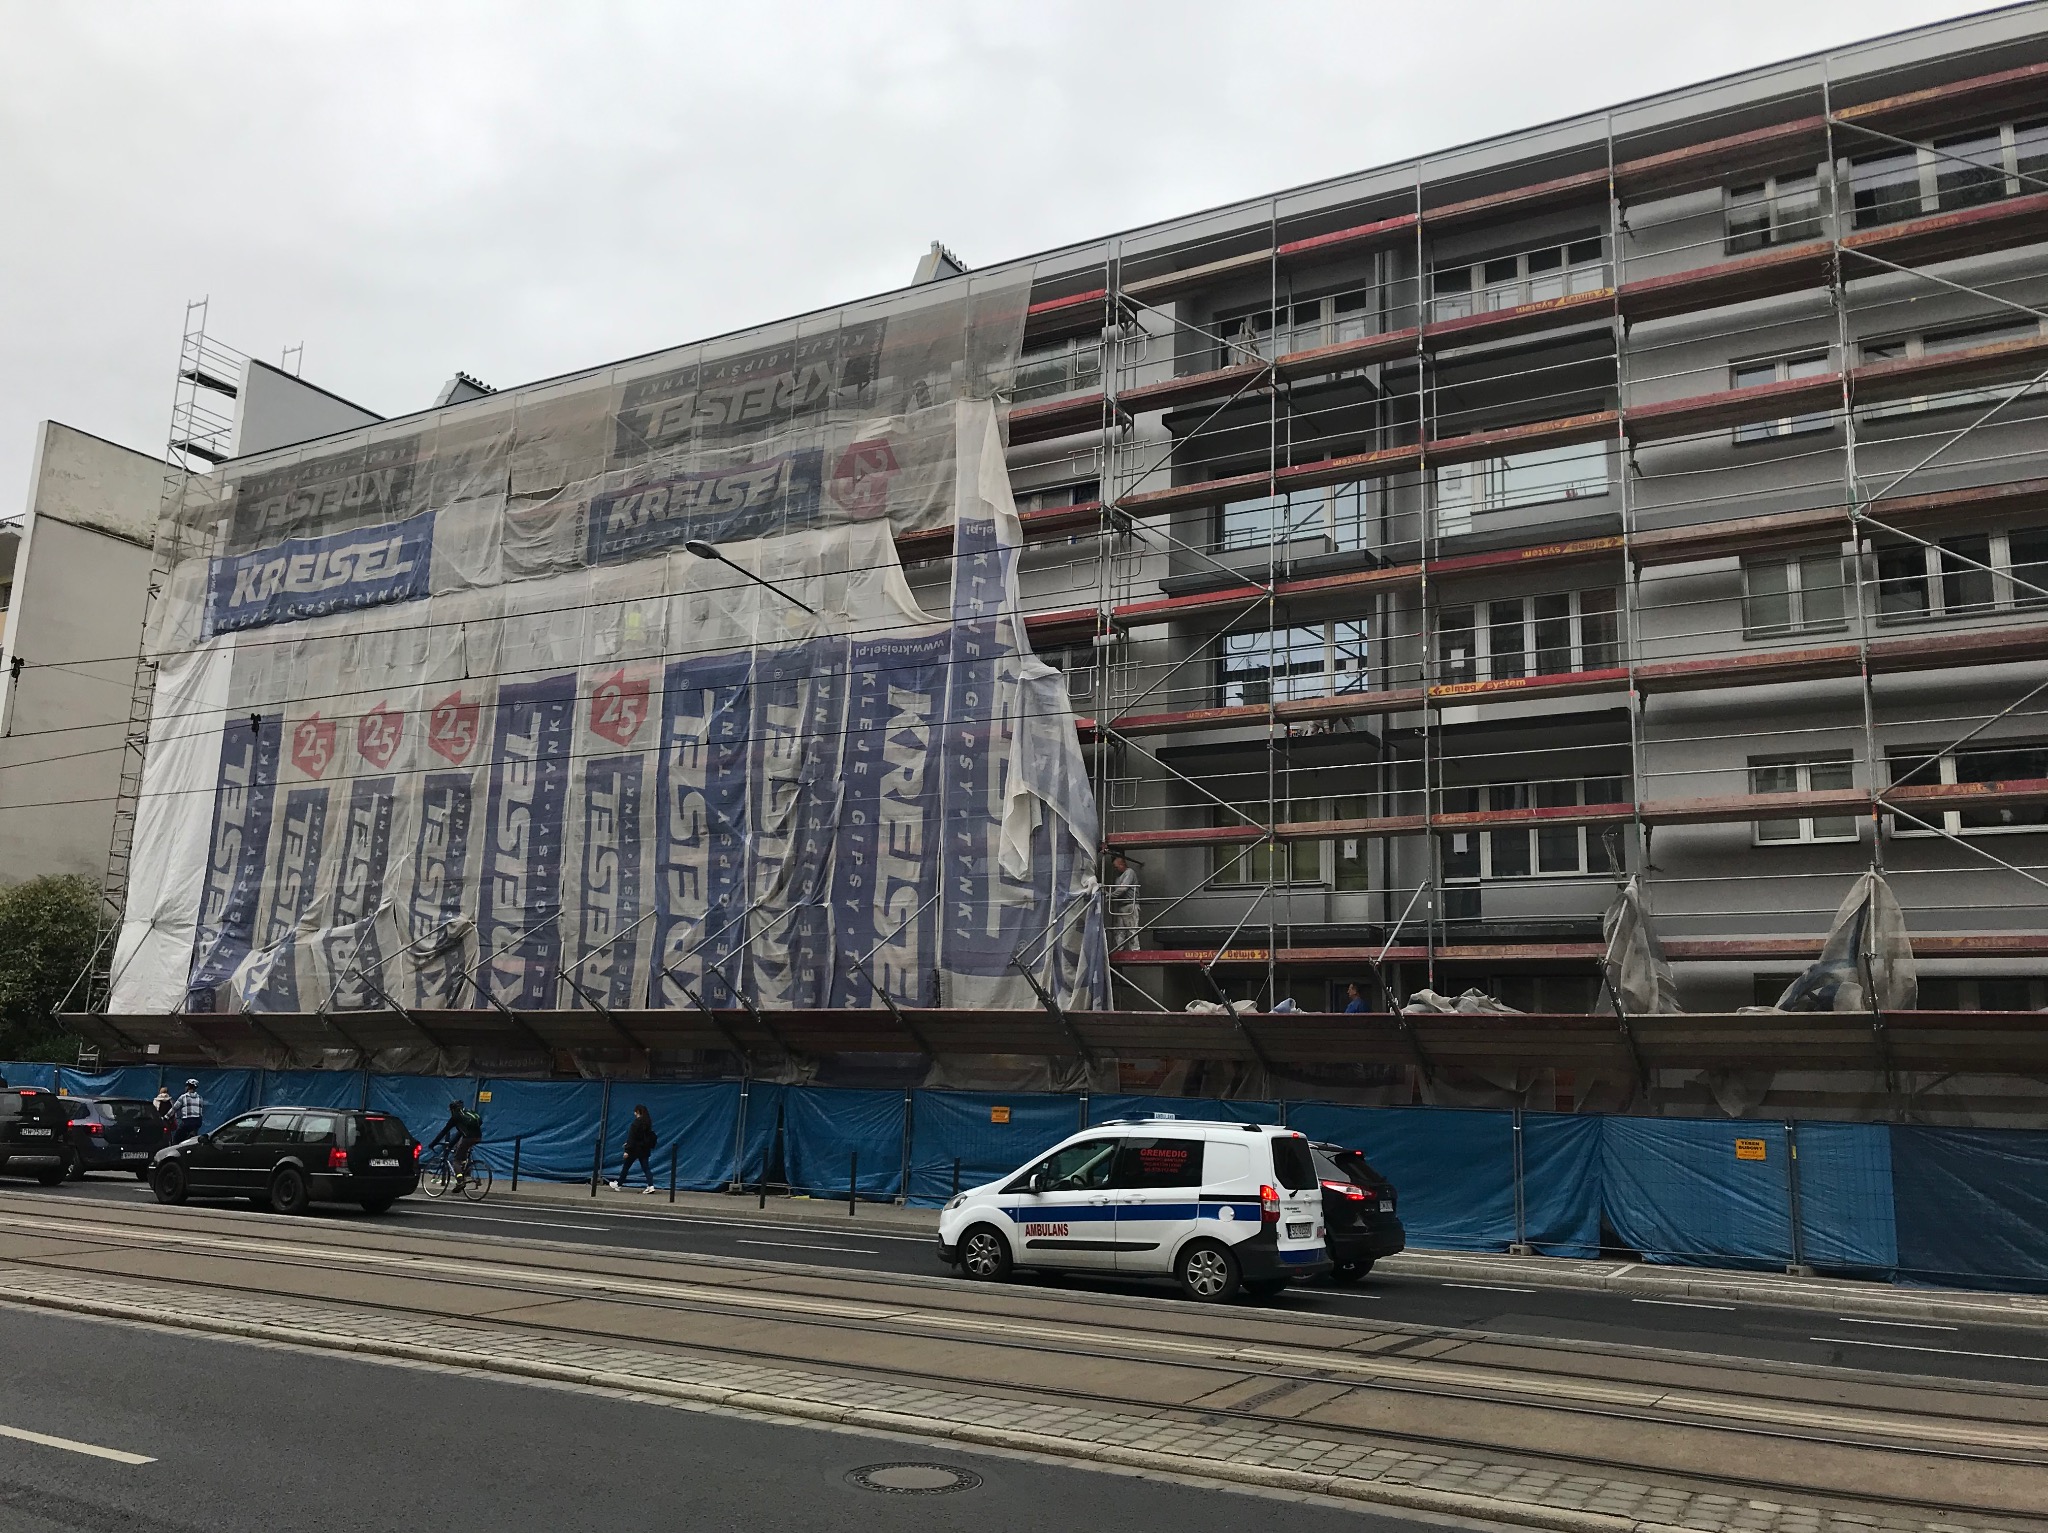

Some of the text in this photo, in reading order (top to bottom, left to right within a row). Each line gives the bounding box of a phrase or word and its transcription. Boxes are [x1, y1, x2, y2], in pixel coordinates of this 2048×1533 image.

[636, 356, 849, 439] KREISEL
[252, 468, 397, 532] KREISEL
[606, 459, 810, 534] KREISEL
[229, 535, 413, 607] KREISEL
[1521, 546, 1561, 559] system
[217, 607, 269, 630] KLEJE
[354, 583, 411, 605] TYNKI
[855, 639, 945, 658] www.kreisel.pl
[598, 684, 640, 737] 25
[1444, 678, 1526, 694] elmag system
[298, 723, 328, 771] 25
[364, 716, 396, 761] 25
[435, 704, 471, 756] 25
[544, 704, 563, 792] TYNKI
[719, 685, 737, 778] TYNKI
[956, 553, 988, 939] KLEJE GIPSY TYNKI
[252, 741, 270, 818] TYNKI
[625, 775, 636, 844] TYNKI
[307, 804, 322, 867] TYNKI
[376, 794, 389, 857] TYNKI
[452, 792, 465, 857] TYNKI
[718, 810, 731, 908] GIPSY
[799, 666, 831, 1004] TYNKI GIPSY LEJE
[844, 672, 876, 1009] KLEJE GIPSY TYN
[870, 684, 932, 1009] KREISE
[230, 846, 256, 922] GIPSY
[487, 712, 541, 1010] KREISEL
[535, 824, 549, 913] GIPSY
[622, 868, 633, 939] GIPSY
[1140, 1148, 1188, 1158] GREMEDIG
[1025, 1223, 1069, 1237] AMBULANS
